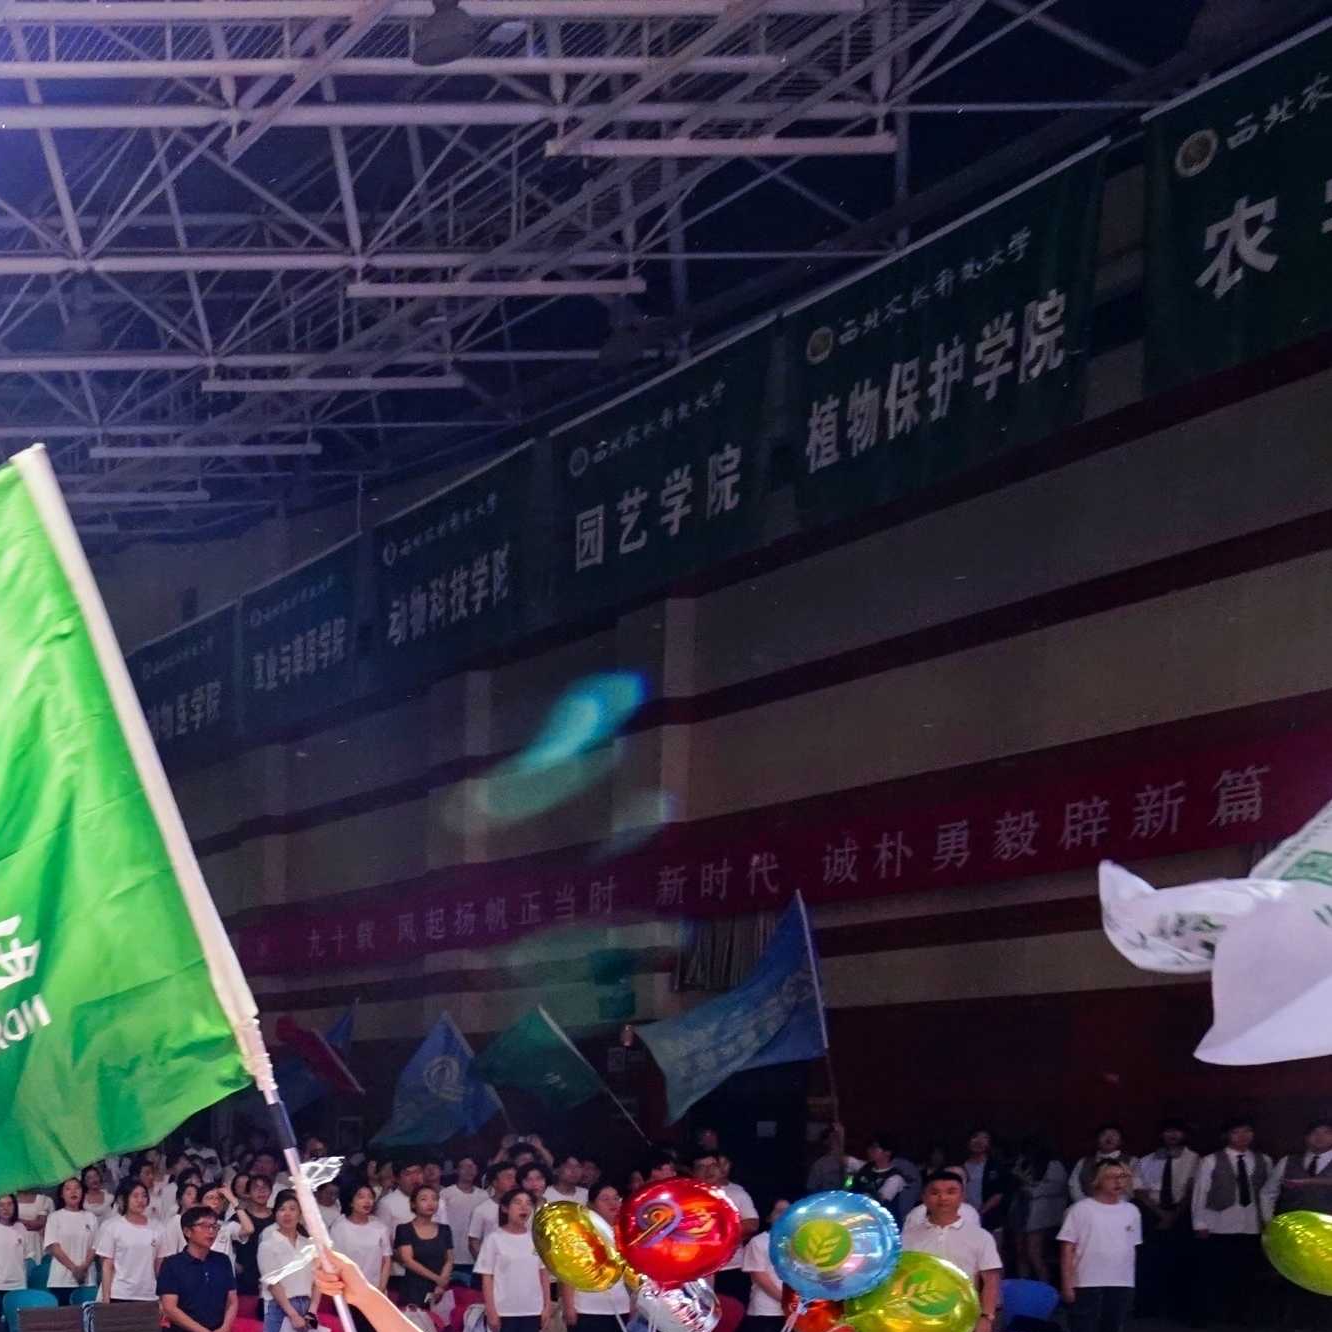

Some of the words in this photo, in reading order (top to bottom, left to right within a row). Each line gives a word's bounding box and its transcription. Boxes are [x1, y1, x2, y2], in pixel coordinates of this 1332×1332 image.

[805, 288, 1067, 474] 植物保护学院
[574, 443, 743, 573] 园艺学院
[655, 853, 781, 905] 新时代
[820, 763, 1269, 885] 诚朴勇毅辟新篇
